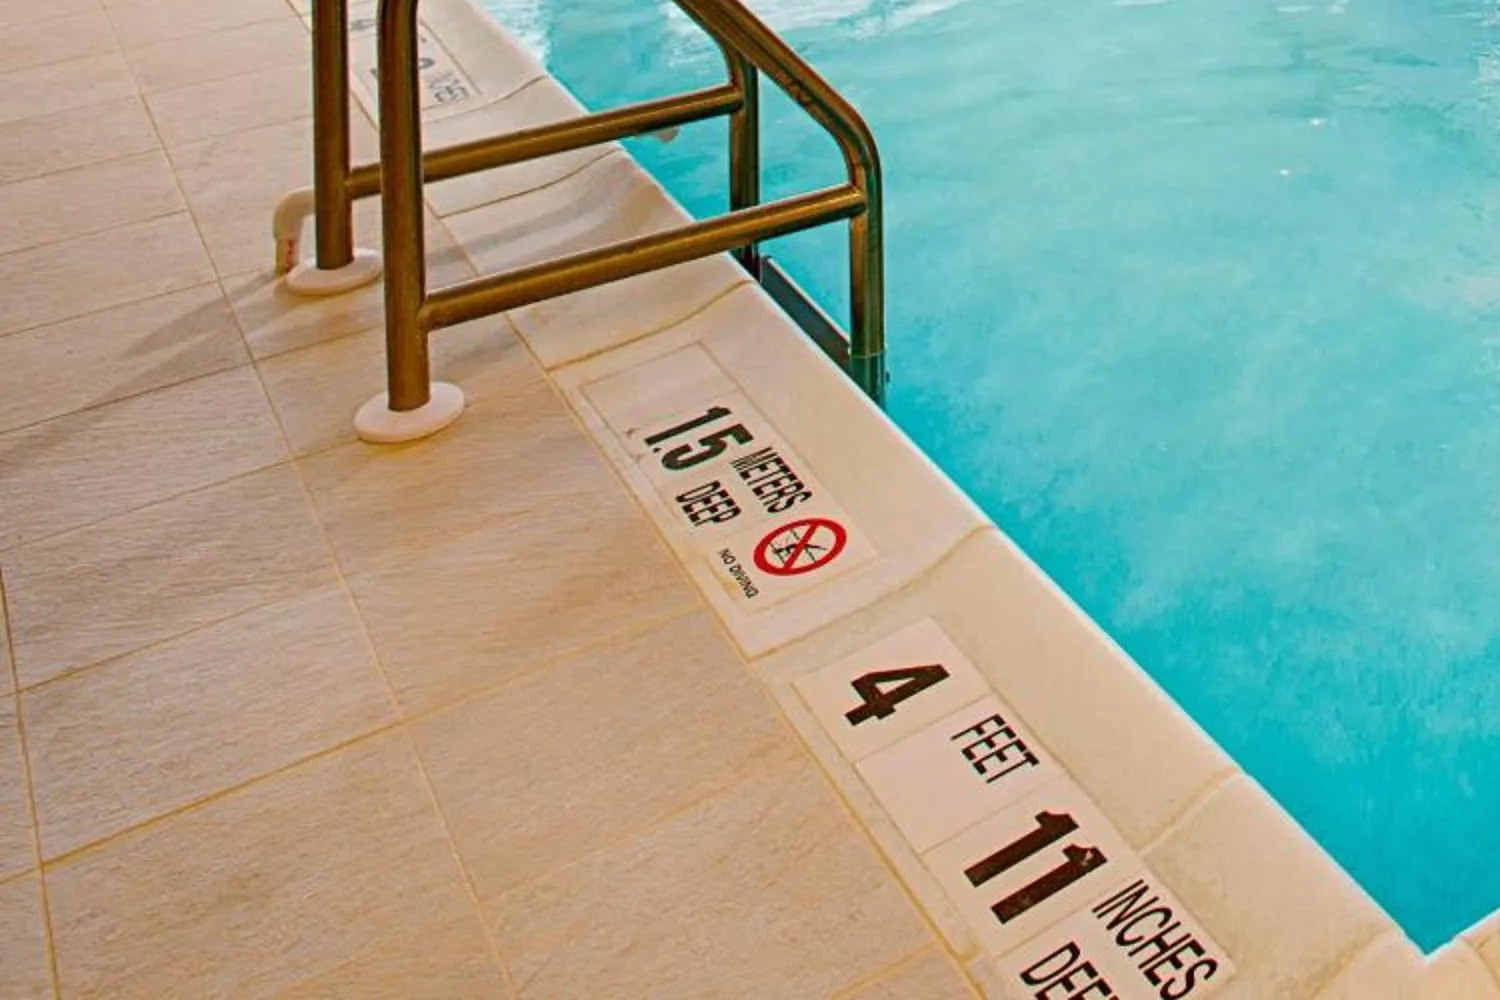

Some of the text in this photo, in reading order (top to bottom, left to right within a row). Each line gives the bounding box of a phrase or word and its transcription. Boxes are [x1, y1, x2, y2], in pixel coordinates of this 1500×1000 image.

[675, 480, 742, 527] DEEP
[729, 446, 813, 514] METERS
[719, 548, 759, 600] NO DIVING
[844, 664, 1219, 1000] 4 FEET 11 INCHES
[1019, 941, 1120, 1000] DEE
